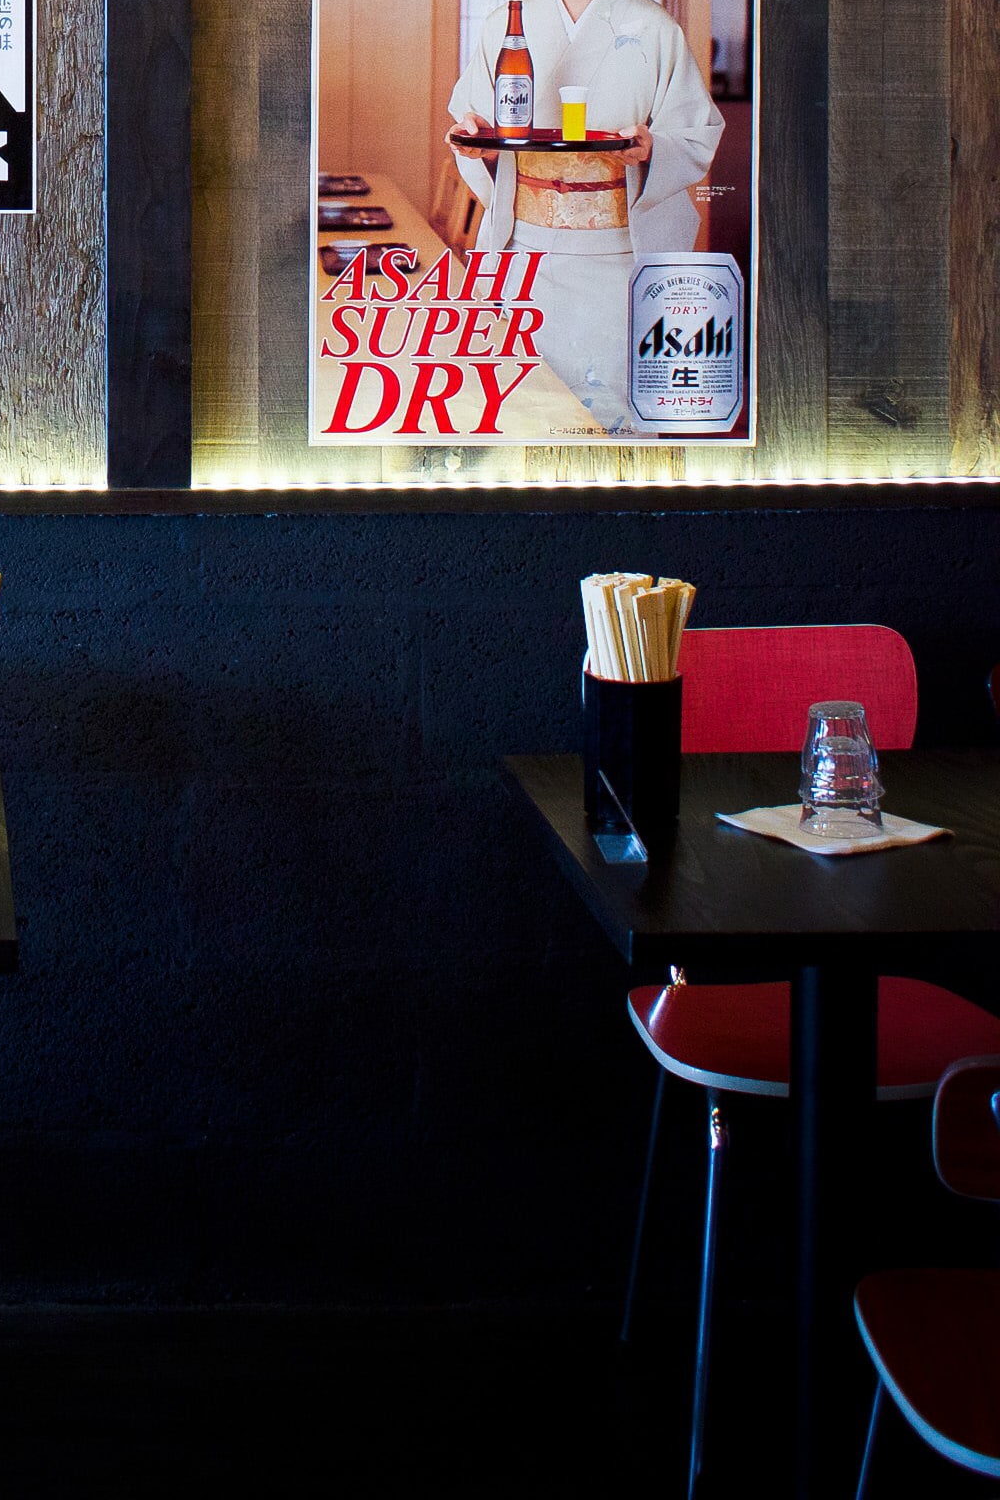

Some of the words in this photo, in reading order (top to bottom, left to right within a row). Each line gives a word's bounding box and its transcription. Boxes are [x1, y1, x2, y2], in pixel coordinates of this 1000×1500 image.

[500, 93, 529, 105] Asahi
[322, 250, 549, 303] ASAHI
[649, 284, 666, 300] ASAHI
[667, 276, 701, 288] BREWERIES
[702, 281, 722, 300] LIMITED
[321, 305, 546, 359] SUPER
[639, 315, 734, 358] Asahi
[672, 366, 700, 388] 生
[321, 361, 539, 435] DRY
[657, 396, 714, 406] スーパードライ
